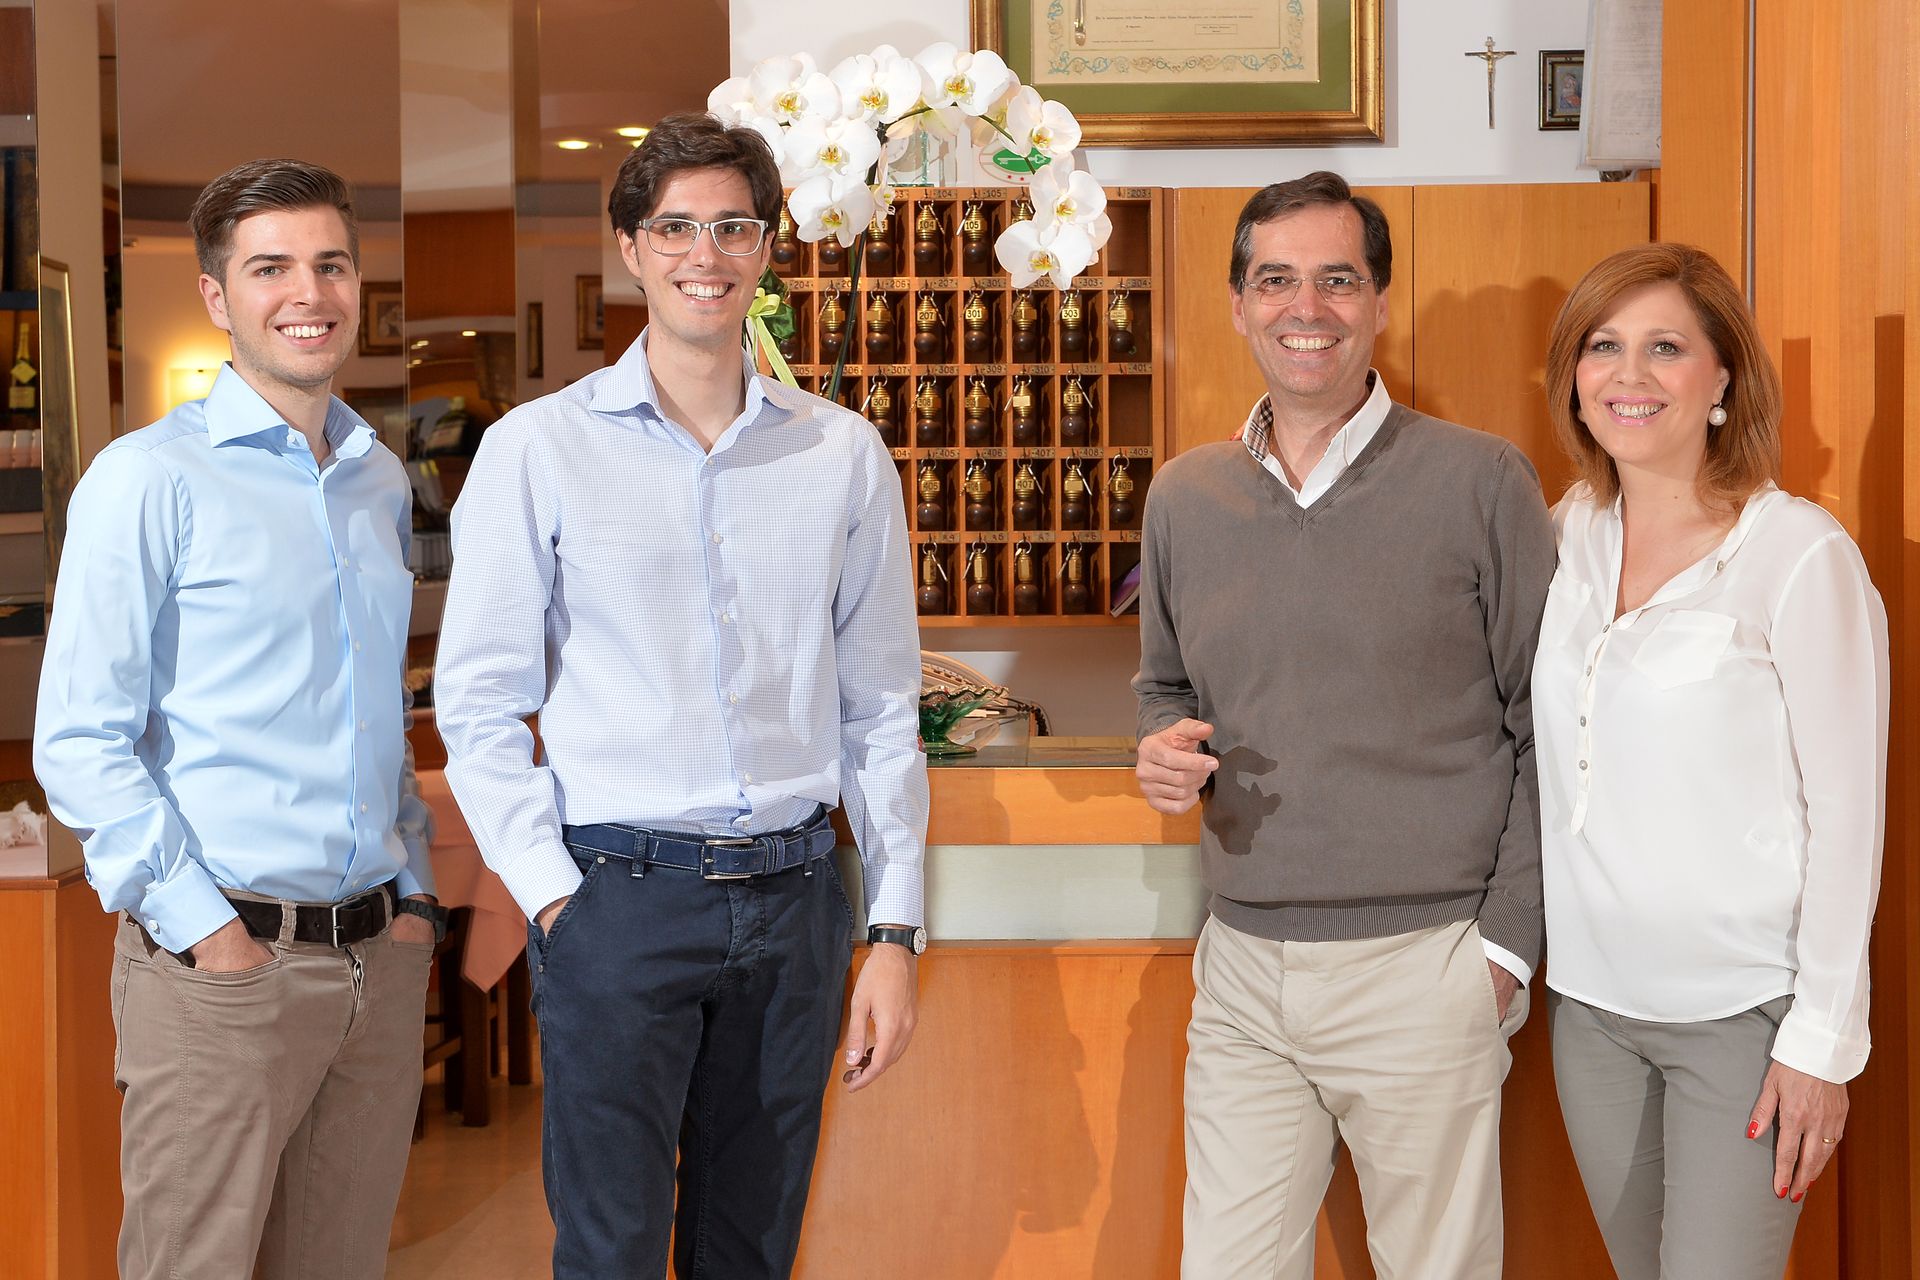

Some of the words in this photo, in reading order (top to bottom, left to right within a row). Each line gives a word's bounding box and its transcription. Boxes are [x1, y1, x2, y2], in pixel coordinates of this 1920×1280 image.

[936, 190, 951, 198] 104
[986, 190, 1002, 198] 105
[919, 220, 934, 229] 104
[965, 220, 979, 229] 105
[794, 280, 809, 289] 204
[841, 280, 852, 288] 20
[938, 280, 953, 288] 207
[986, 279, 1001, 287] 301
[1083, 279, 1098, 287] 303
[1132, 279, 1147, 287] 304
[919, 311, 934, 320] 207
[967, 309, 981, 318] 301
[1063, 309, 1078, 318] 303
[794, 367, 809, 375] 305
[891, 366, 907, 374] 307
[986, 365, 1002, 373] 309
[1034, 365, 1050, 373] 310
[1132, 364, 1147, 372] 401
[873, 398, 888, 407] 307
[1066, 395, 1080, 403] 311
[941, 449, 956, 457] 405
[1035, 449, 1050, 457] 407
[1133, 448, 1149, 456] 409
[923, 481, 938, 491] 405
[1017, 480, 1032, 489] 407
[1117, 480, 1132, 490] 409
